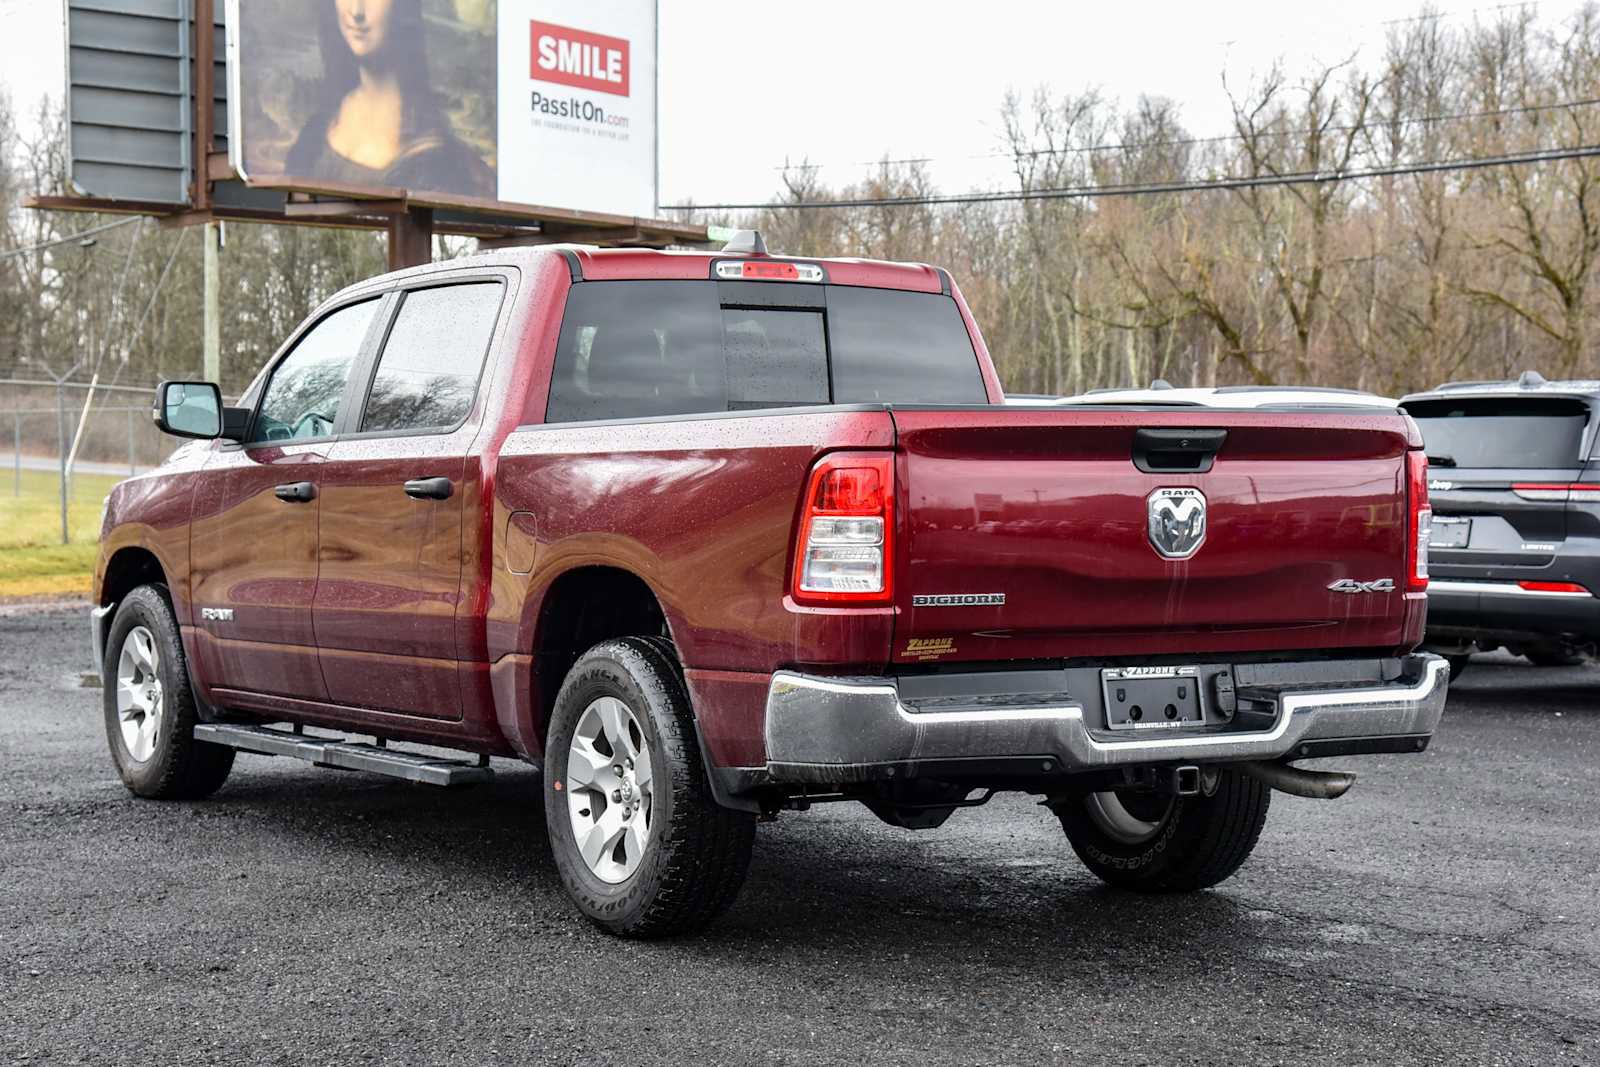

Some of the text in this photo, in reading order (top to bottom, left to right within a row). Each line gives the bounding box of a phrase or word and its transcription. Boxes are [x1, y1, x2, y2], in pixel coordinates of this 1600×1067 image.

[537, 35, 624, 83] SMILE
[531, 91, 629, 128] PassItOn.com
[1429, 480, 1452, 491] Jeep
[1521, 543, 1555, 551] LIMITED
[912, 593, 1006, 607] BIGHORN
[201, 607, 234, 620] RAM
[907, 638, 954, 651] ZAPPONE
[1126, 666, 1175, 679] ZAPPONE
